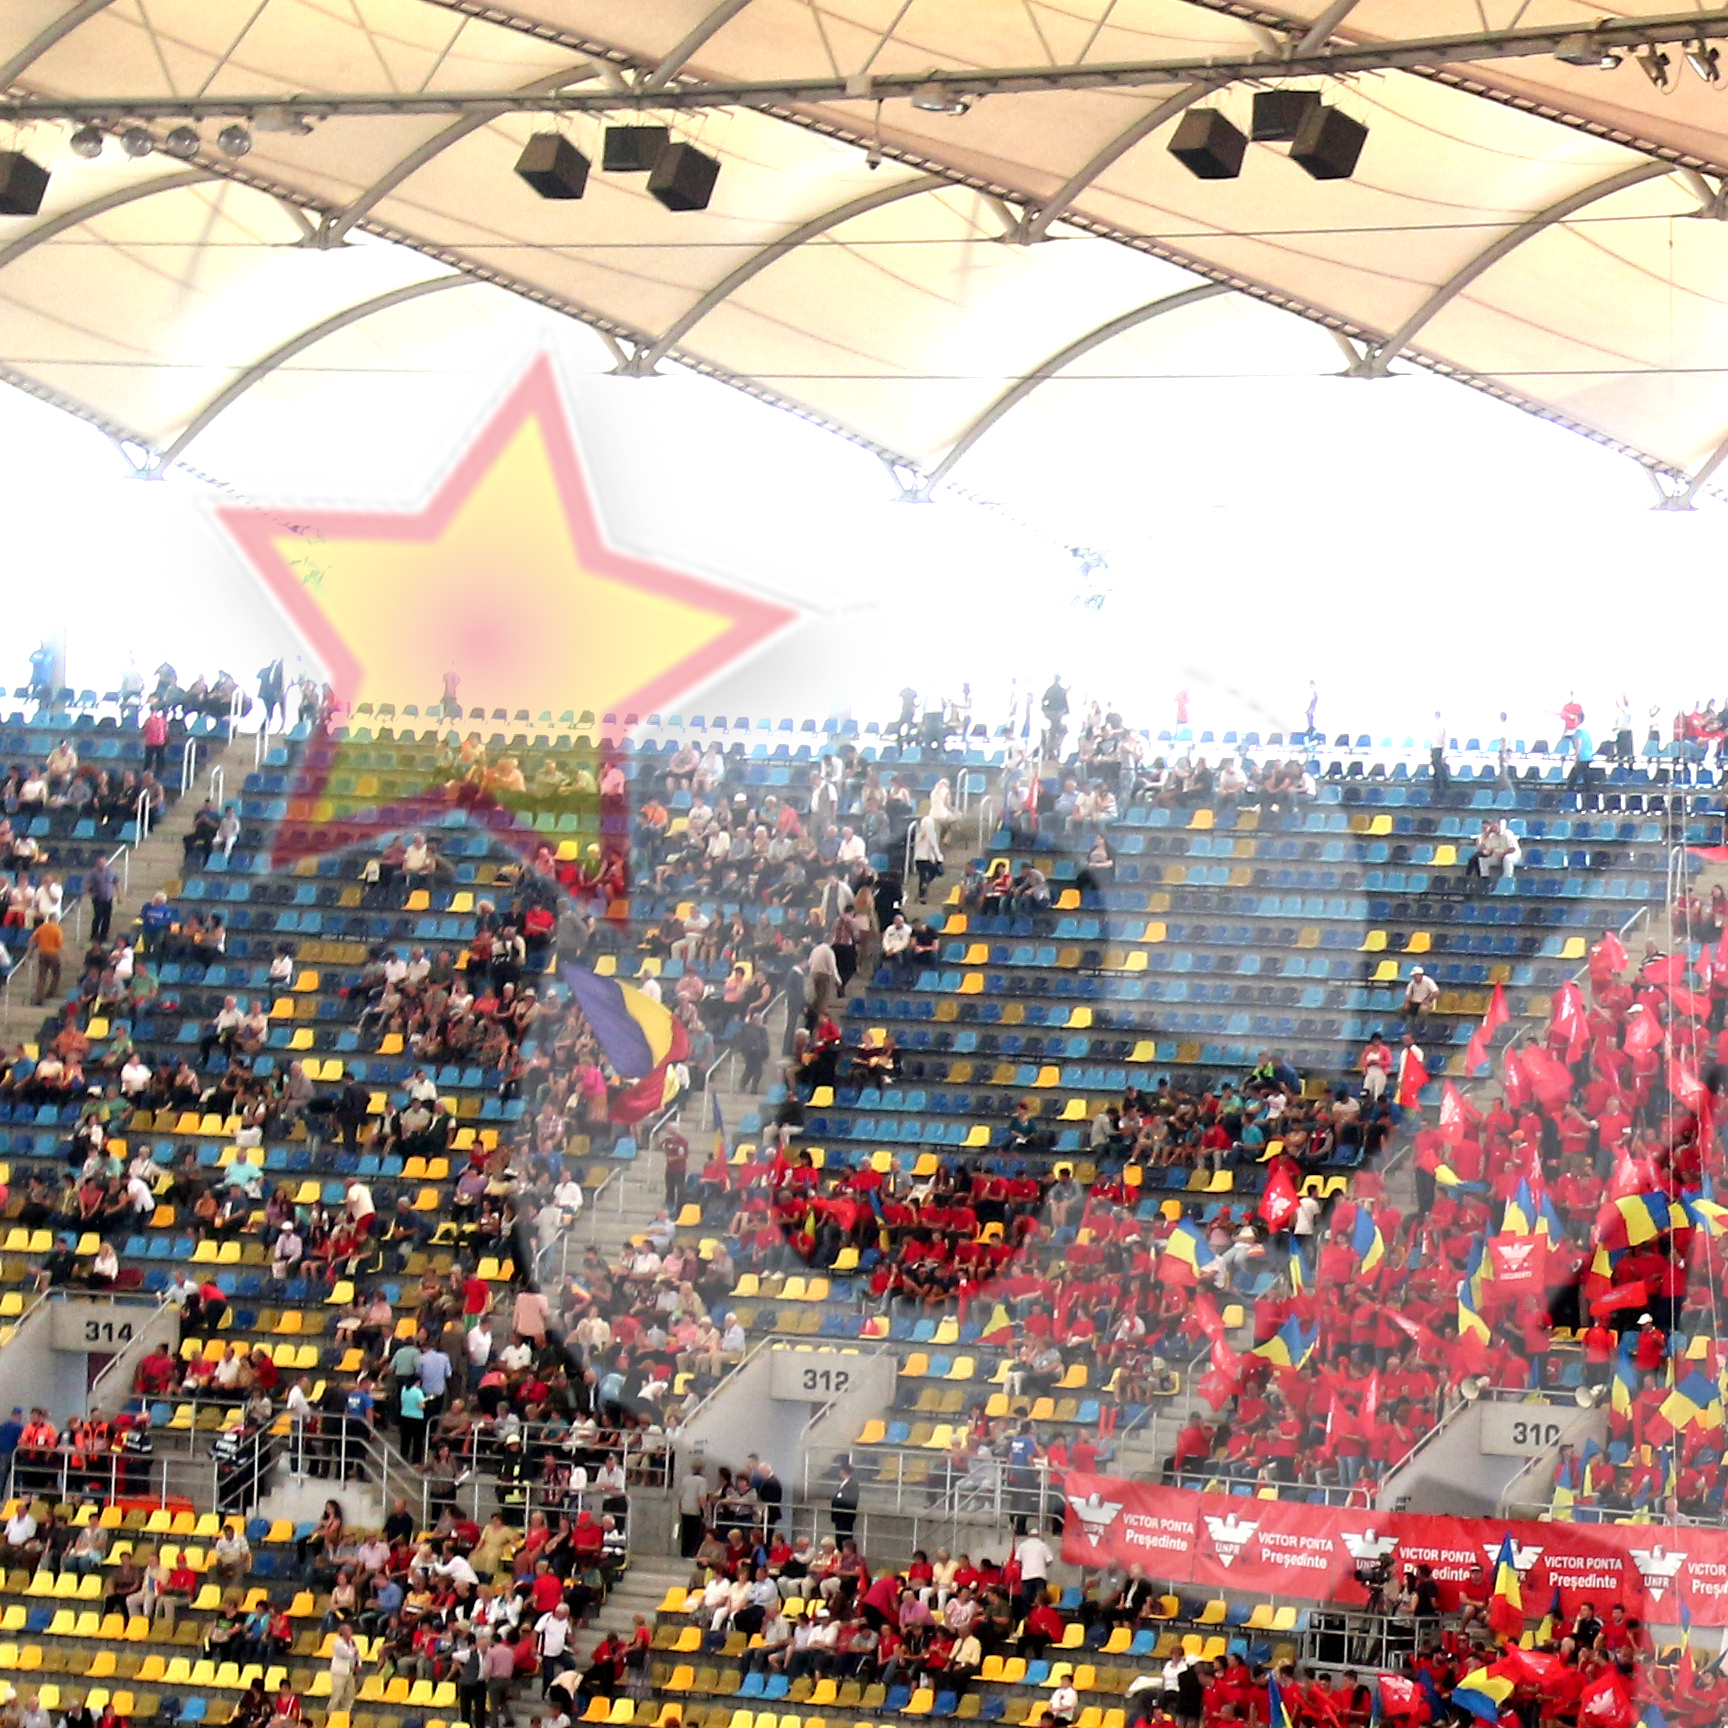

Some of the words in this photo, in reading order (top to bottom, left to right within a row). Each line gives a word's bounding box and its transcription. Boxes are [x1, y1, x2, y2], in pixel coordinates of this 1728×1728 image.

[85, 1320, 133, 1342] 314
[803, 1369, 849, 1393] 312
[1512, 1422, 1560, 1446] 310
[1123, 1512, 1159, 1529] VICTOR
[1160, 1518, 1194, 1535] PONTA
[1258, 1531, 1298, 1548] VICTOR
[1299, 1536, 1333, 1552] PONTA
[1399, 1546, 1440, 1561] VICTOR
[1441, 1549, 1477, 1564] PONTA
[1544, 1556, 1583, 1569] VICTOR
[1585, 1557, 1623, 1570] PONTA
[1687, 1562, 1726, 1578] VICTOR
[1549, 1571, 1617, 1591] Președinte
